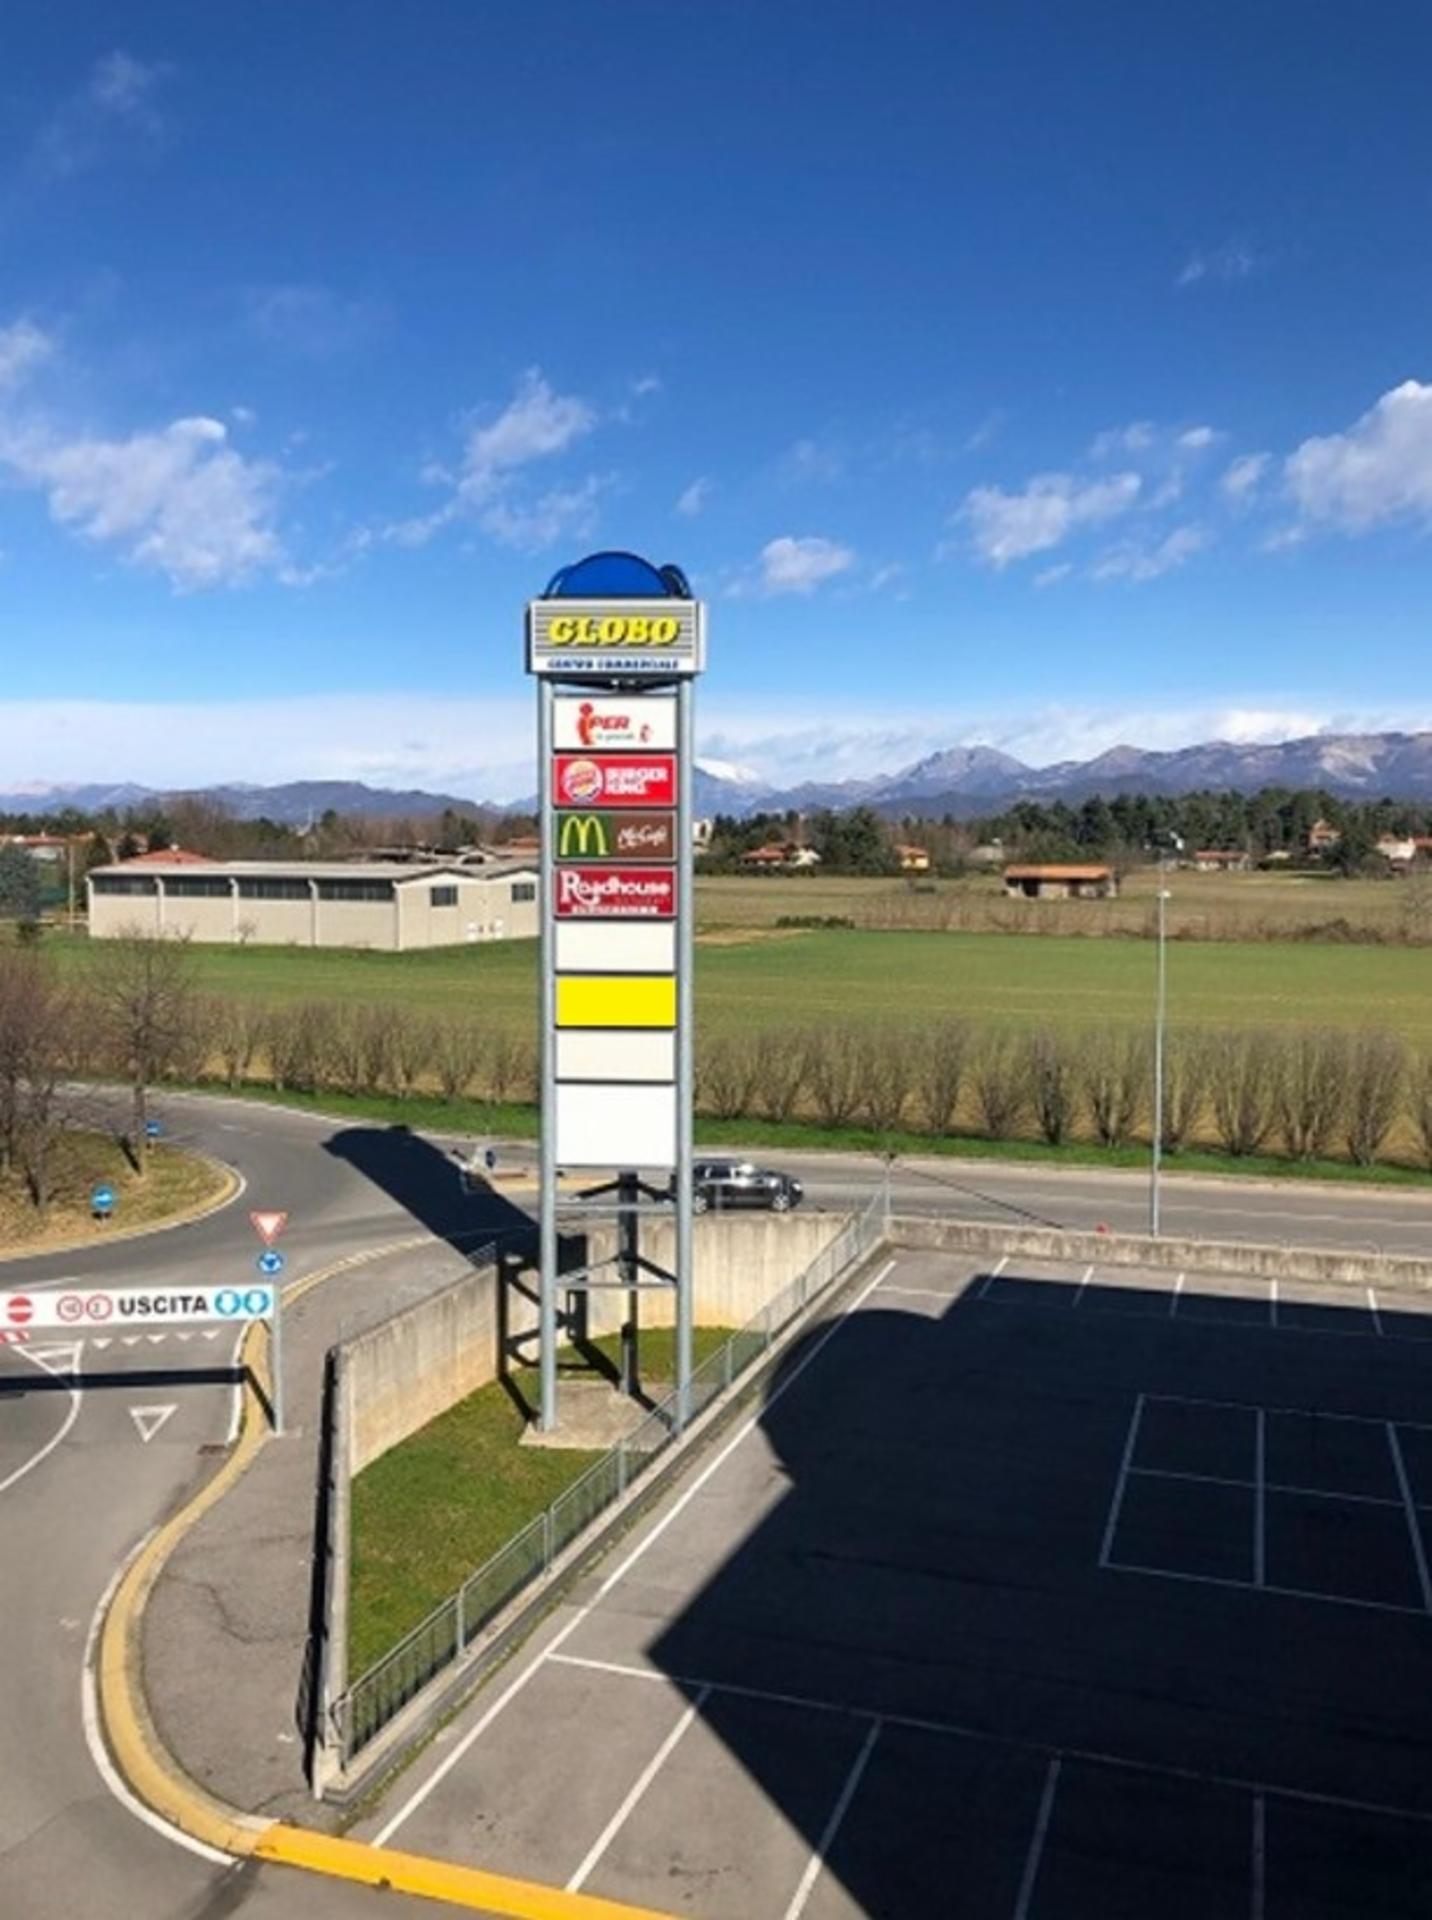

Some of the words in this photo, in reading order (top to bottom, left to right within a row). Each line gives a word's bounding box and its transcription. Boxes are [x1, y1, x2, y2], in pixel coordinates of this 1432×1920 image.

[549, 616, 679, 645] GLOBO
[560, 870, 671, 905] Roadhouse
[119, 1295, 208, 1316] USCITA
